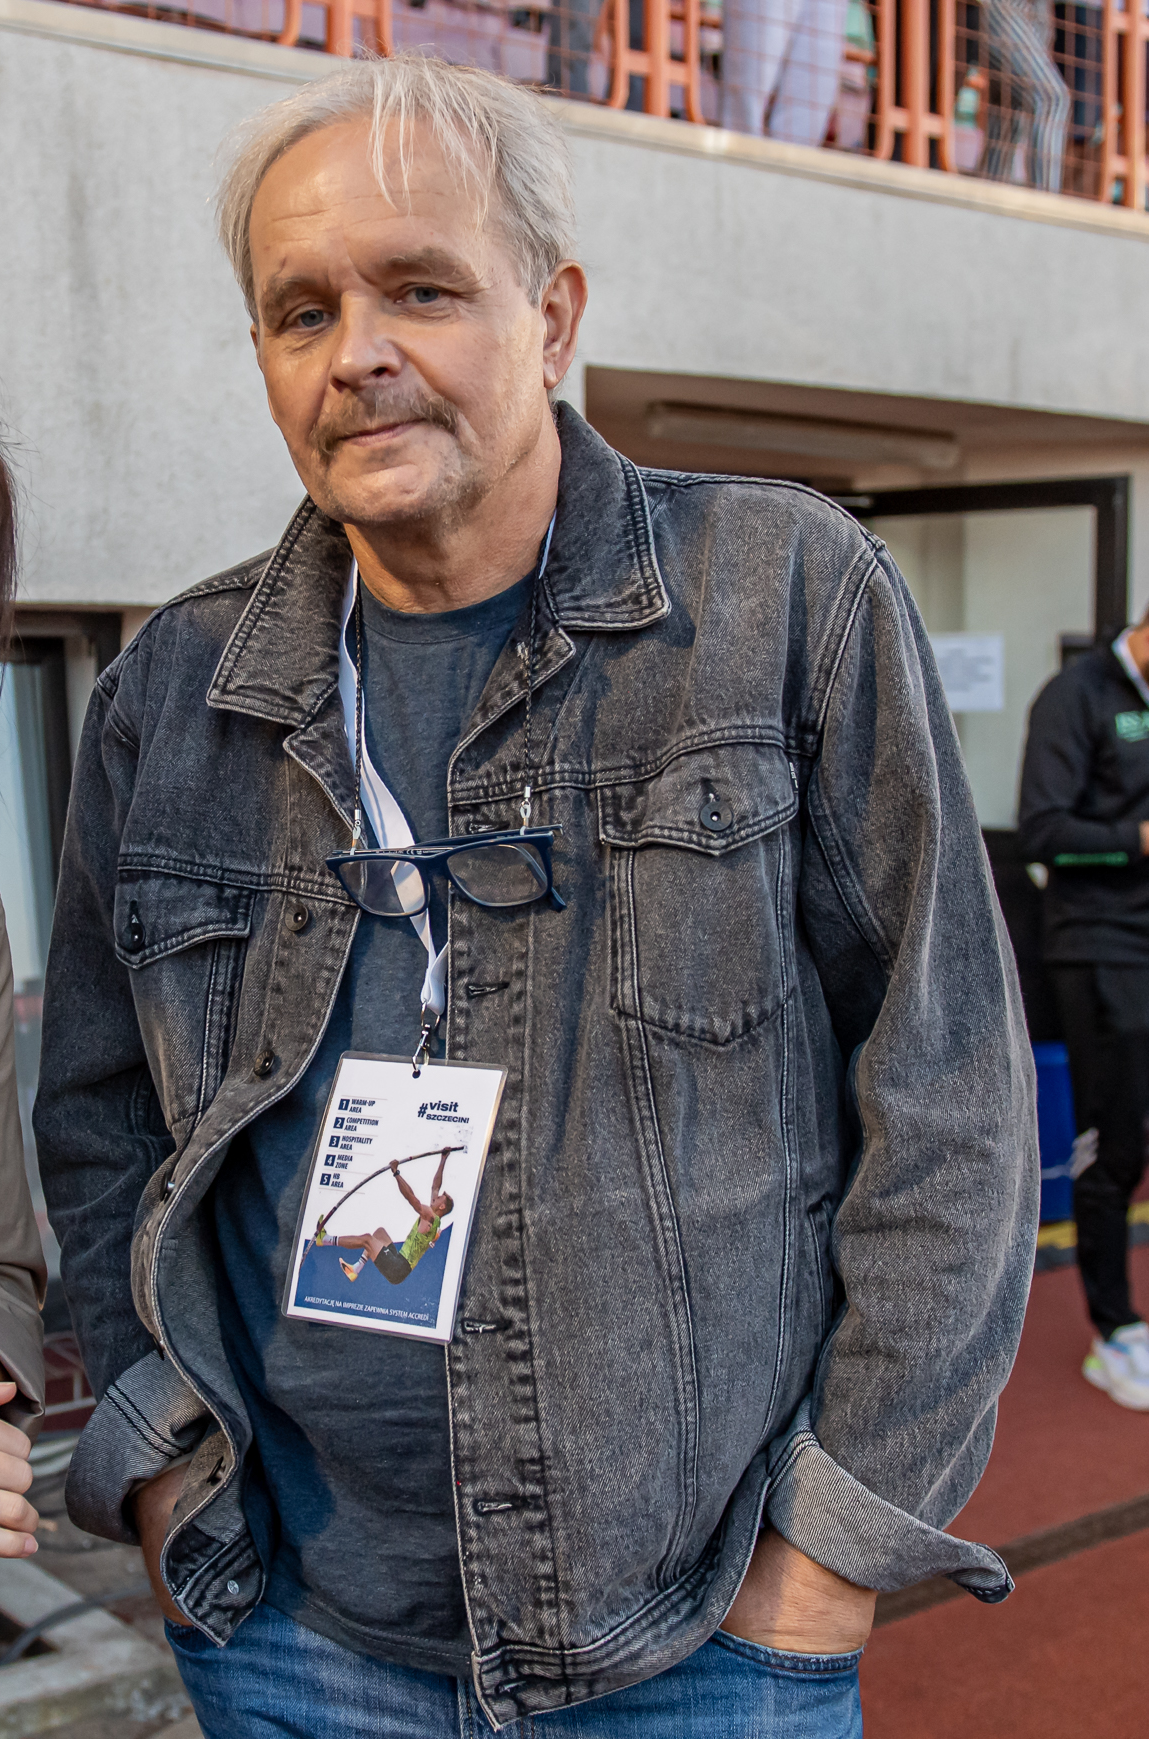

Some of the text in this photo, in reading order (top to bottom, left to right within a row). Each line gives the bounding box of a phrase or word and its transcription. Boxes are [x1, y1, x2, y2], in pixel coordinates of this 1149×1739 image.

[346, 1117, 379, 1126] COMPETITION
[341, 1136, 373, 1145] HOSPITALITY
[337, 1154, 353, 1162] MEDIA
[364, 1306, 389, 1315] ZAPEWNIA
[389, 1309, 408, 1318] SYSTEM
